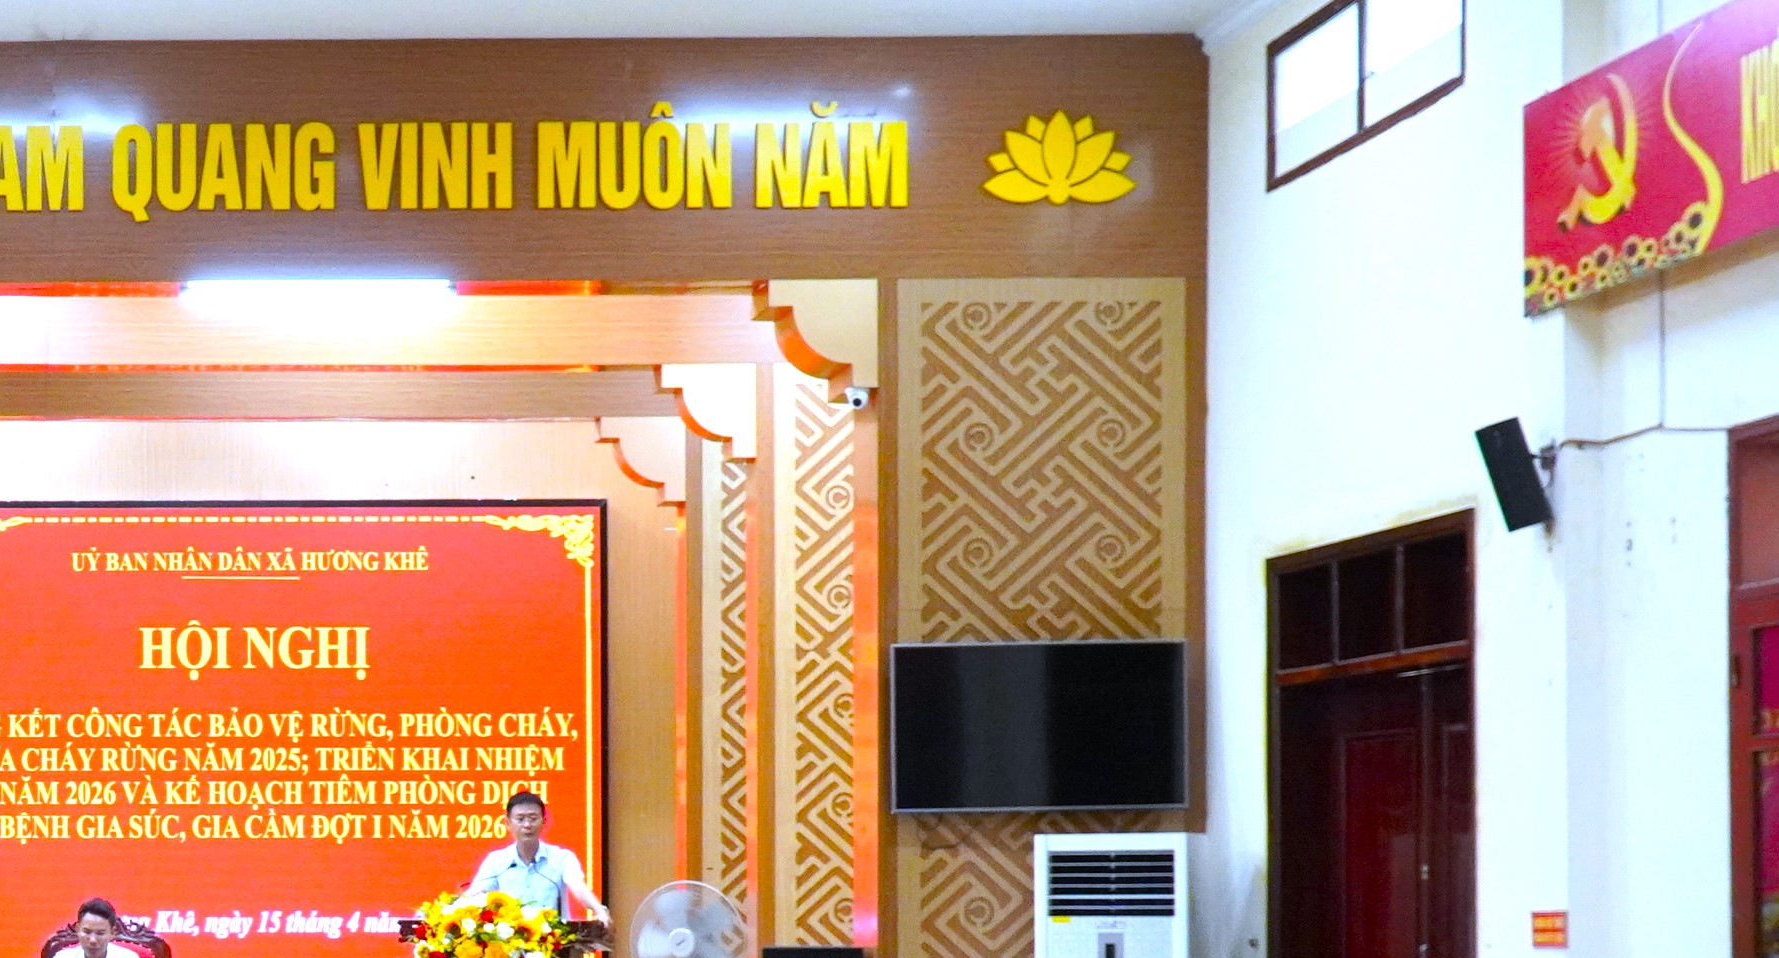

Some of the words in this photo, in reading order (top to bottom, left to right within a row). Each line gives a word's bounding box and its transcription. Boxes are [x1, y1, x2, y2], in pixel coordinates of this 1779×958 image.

[112, 122, 335, 222] QUANG
[358, 122, 513, 209] VINH
[537, 102, 732, 209] MUÔN
[755, 101, 909, 209] NĂM
[71, 547, 100, 571] UỶ
[106, 552, 148, 571] BAN
[153, 547, 212, 571] NHÂN
[215, 547, 263, 571] DÂN
[266, 547, 300, 571] XÃ
[301, 549, 380, 571] HƯƠNG
[384, 545, 429, 571] KHÊ
[138, 619, 232, 681] HỘI
[242, 625, 371, 681] NGHỊ
[7, 707, 61, 738] KẾT
[67, 707, 144, 738] CÔNG
[149, 707, 202, 738] TÁC
[207, 706, 264, 738] BẢO
[270, 711, 304, 743] VỆ
[309, 708, 394, 741] RỪNG,
[399, 707, 493, 737] PHÒNG
[498, 707, 578, 741] CHÁY,
[21, 742, 95, 772] CHÁY
[101, 741, 177, 772] RỪNG
[183, 742, 244, 772] NĂM
[250, 747, 309, 775] 2025;
[315, 741, 395, 771] TRIỂN
[401, 747, 469, 771] KHAI
[475, 744, 565, 776] NHIỆM
[0, 776, 59, 805] NĂM
[65, 781, 117, 805] 2026
[122, 775, 159, 805] VÀ
[164, 775, 201, 805] KẾ
[207, 780, 303, 810] HOẠCH
[309, 774, 377, 805] TIÊM
[382, 775, 476, 805] PHÒNG
[0, 812, 71, 845] BỆNH
[76, 814, 124, 839] GIA
[129, 809, 187, 844] SÚC,
[192, 814, 240, 839] GIA
[244, 809, 305, 839] CẦM
[311, 814, 367, 844] ĐỢT
[373, 815, 383, 838] I
[388, 809, 450, 838] NĂM
[455, 814, 507, 839] 2026
[155, 910, 200, 936] Khê,
[204, 911, 253, 938] ngày
[256, 911, 282, 933] 15
[285, 911, 343, 939] tháng
[346, 911, 361, 933] 4
